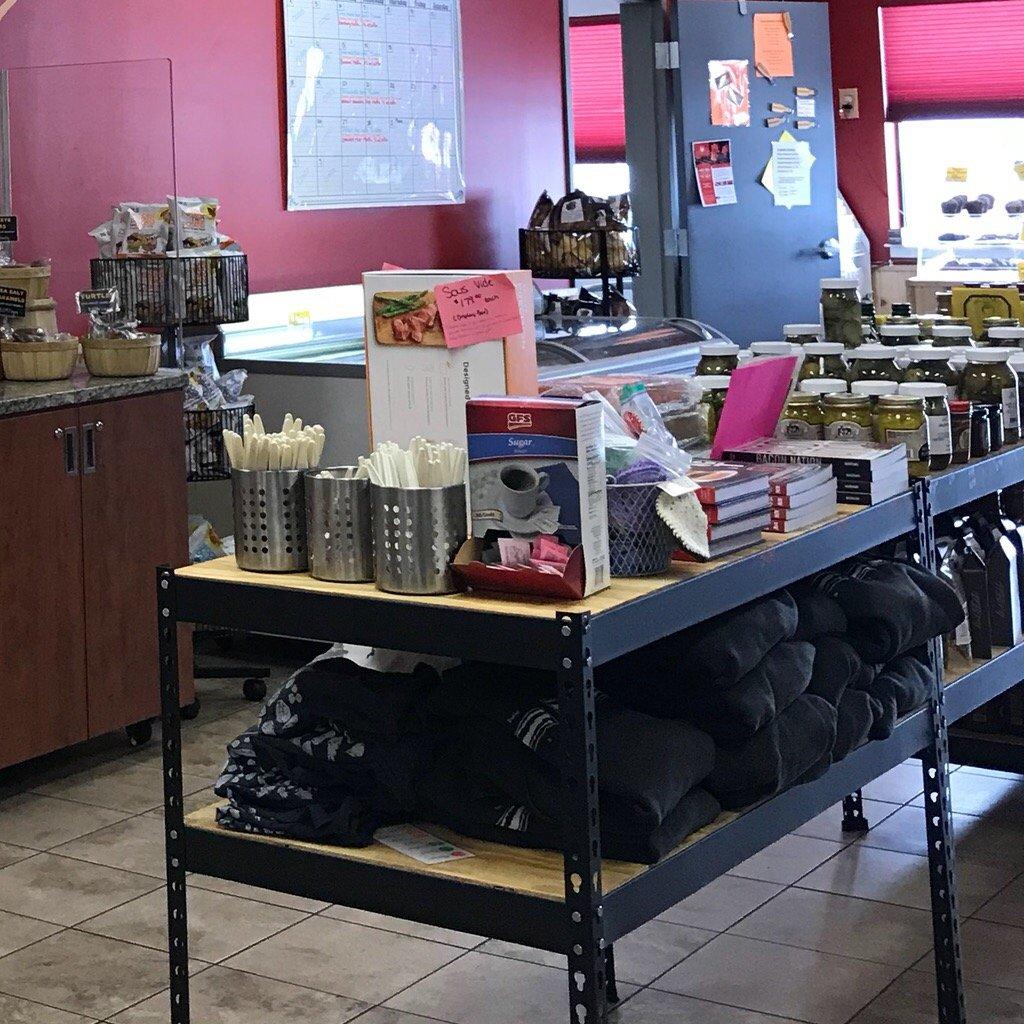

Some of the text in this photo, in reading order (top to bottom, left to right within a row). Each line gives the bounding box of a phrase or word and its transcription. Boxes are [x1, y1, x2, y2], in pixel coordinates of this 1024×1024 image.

[463, 361, 471, 401] Designed
[508, 413, 532, 423] GFS
[508, 437, 533, 448] Sugar
